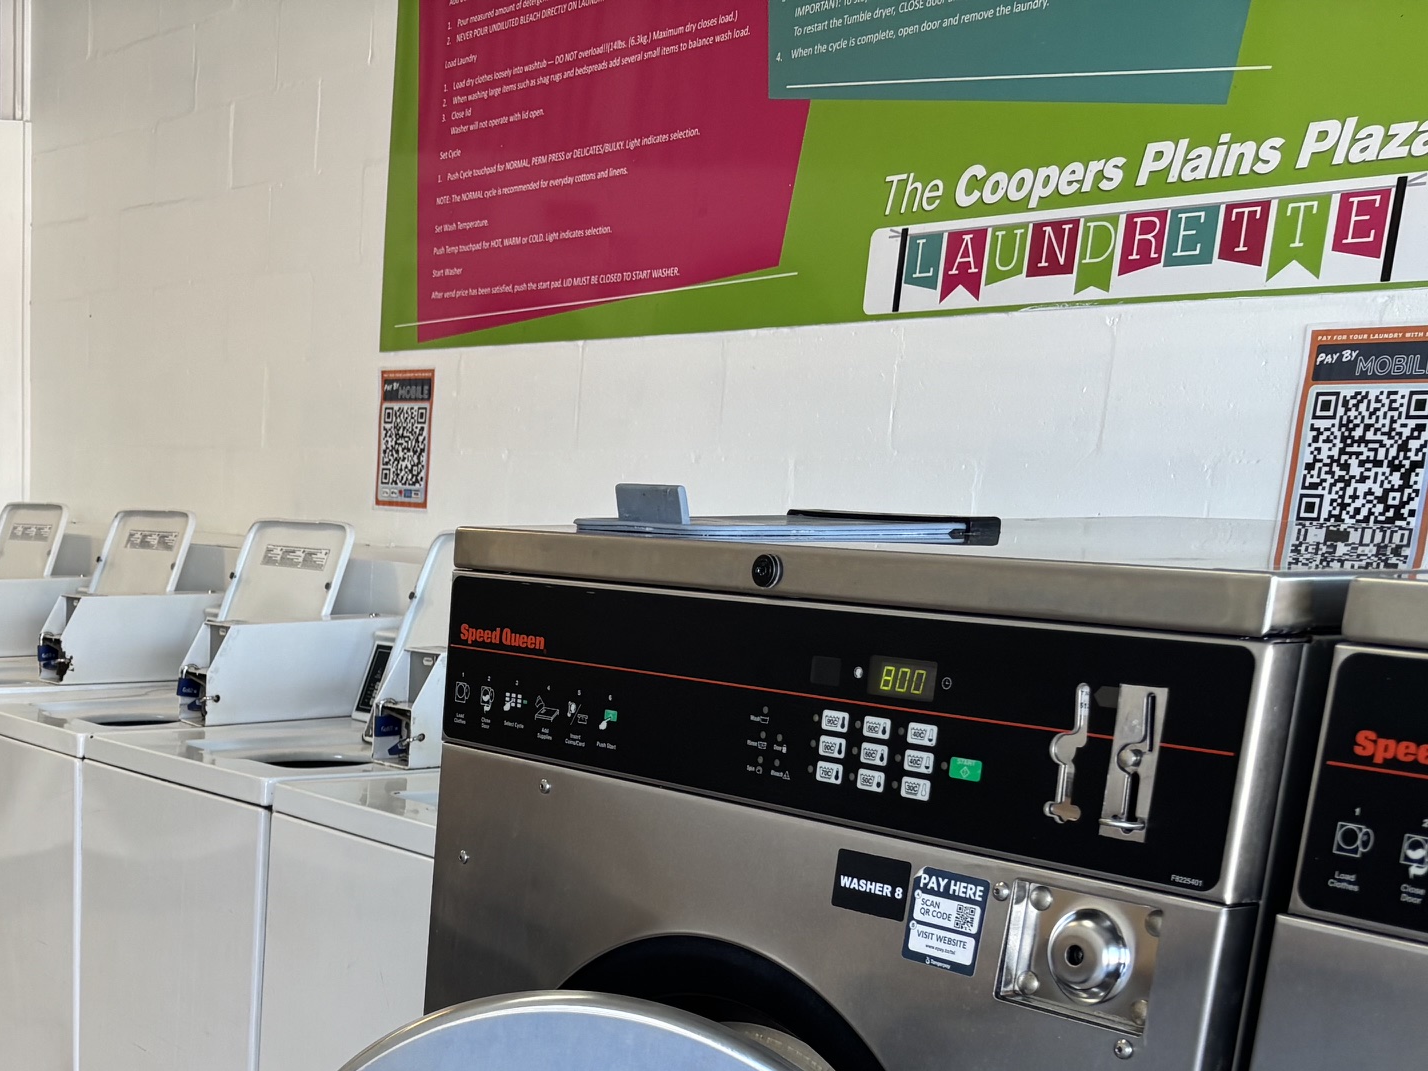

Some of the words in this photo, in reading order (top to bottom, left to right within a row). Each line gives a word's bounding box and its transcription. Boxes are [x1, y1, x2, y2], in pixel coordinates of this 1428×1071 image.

[793, 25, 802, 36] To
[803, 20, 827, 34] restart
[829, 17, 842, 28] the
[843, 10, 872, 24] Tumble
[873, 6, 895, 18] dryer,
[898, 0, 924, 13] CLOSE
[775, 51, 782, 61] 4.
[790, 47, 812, 58] When
[814, 43, 826, 54] the
[828, 38, 848, 52] cycle
[849, 36, 855, 46] is
[856, 29, 895, 44] complete,
[897, 24, 918, 37] open
[920, 20, 940, 31] door
[942, 13, 958, 27] and
[960, 9, 994, 23] remove
[995, 4, 1011, 16] the
[1013, 0, 1049, 12] laundry.
[452, 79, 465, 90] Load
[465, 77, 473, 86] dry
[474, 73, 493, 84] clothes
[493, 68, 511, 79] loosely
[512, 66, 523, 74] into
[523, 59, 547, 71] washtub
[554, 54, 564, 64] DO
[565, 50, 577, 61] NOT
[652, 26, 684, 39] Maximum
[685, 22, 695, 32] dry
[697, 17, 717, 29] closes
[718, 11, 737, 23] load.)
[884, 172, 943, 216] The
[954, 155, 1127, 209] Coopers
[1135, 133, 1285, 188] Plains
[912, 194, 1381, 279] LAUNDRETTE
[468, 287, 477, 295] has
[477, 287, 490, 295] been
[513, 282, 526, 293] push
[527, 281, 537, 290] the
[537, 280, 549, 289] start
[550, 278, 562, 289] pad.
[563, 277, 572, 287] LID
[572, 275, 589, 285] MUST
[590, 274, 598, 284] BE
[599, 272, 621, 283] CLOSED
[623, 271, 631, 281] TO
[632, 269, 650, 280] START
[651, 266, 679, 277] WASHER.
[1316, 352, 1340, 366] PAY
[1355, 354, 1428, 376] MOBIL
[398, 386, 429, 399] MOBILE
[460, 623, 501, 644] Speed
[502, 628, 545, 650] Queen
[1354, 807, 1361, 816] 1
[840, 874, 892, 898] WASHER
[894, 887, 903, 899] 8
[1327, 878, 1360, 892] Clothes
[1334, 870, 1357, 882] Load
[920, 874, 948, 892] PAY
[949, 880, 984, 901] HERE
[1400, 883, 1426, 895] Close
[920, 898, 941, 909] SCAN
[1400, 893, 1423, 904] Door
[919, 907, 930, 917] QR
[932, 910, 952, 922] CODE
[917, 929, 935, 941] VISIT
[936, 934, 968, 950] WEBSITE
